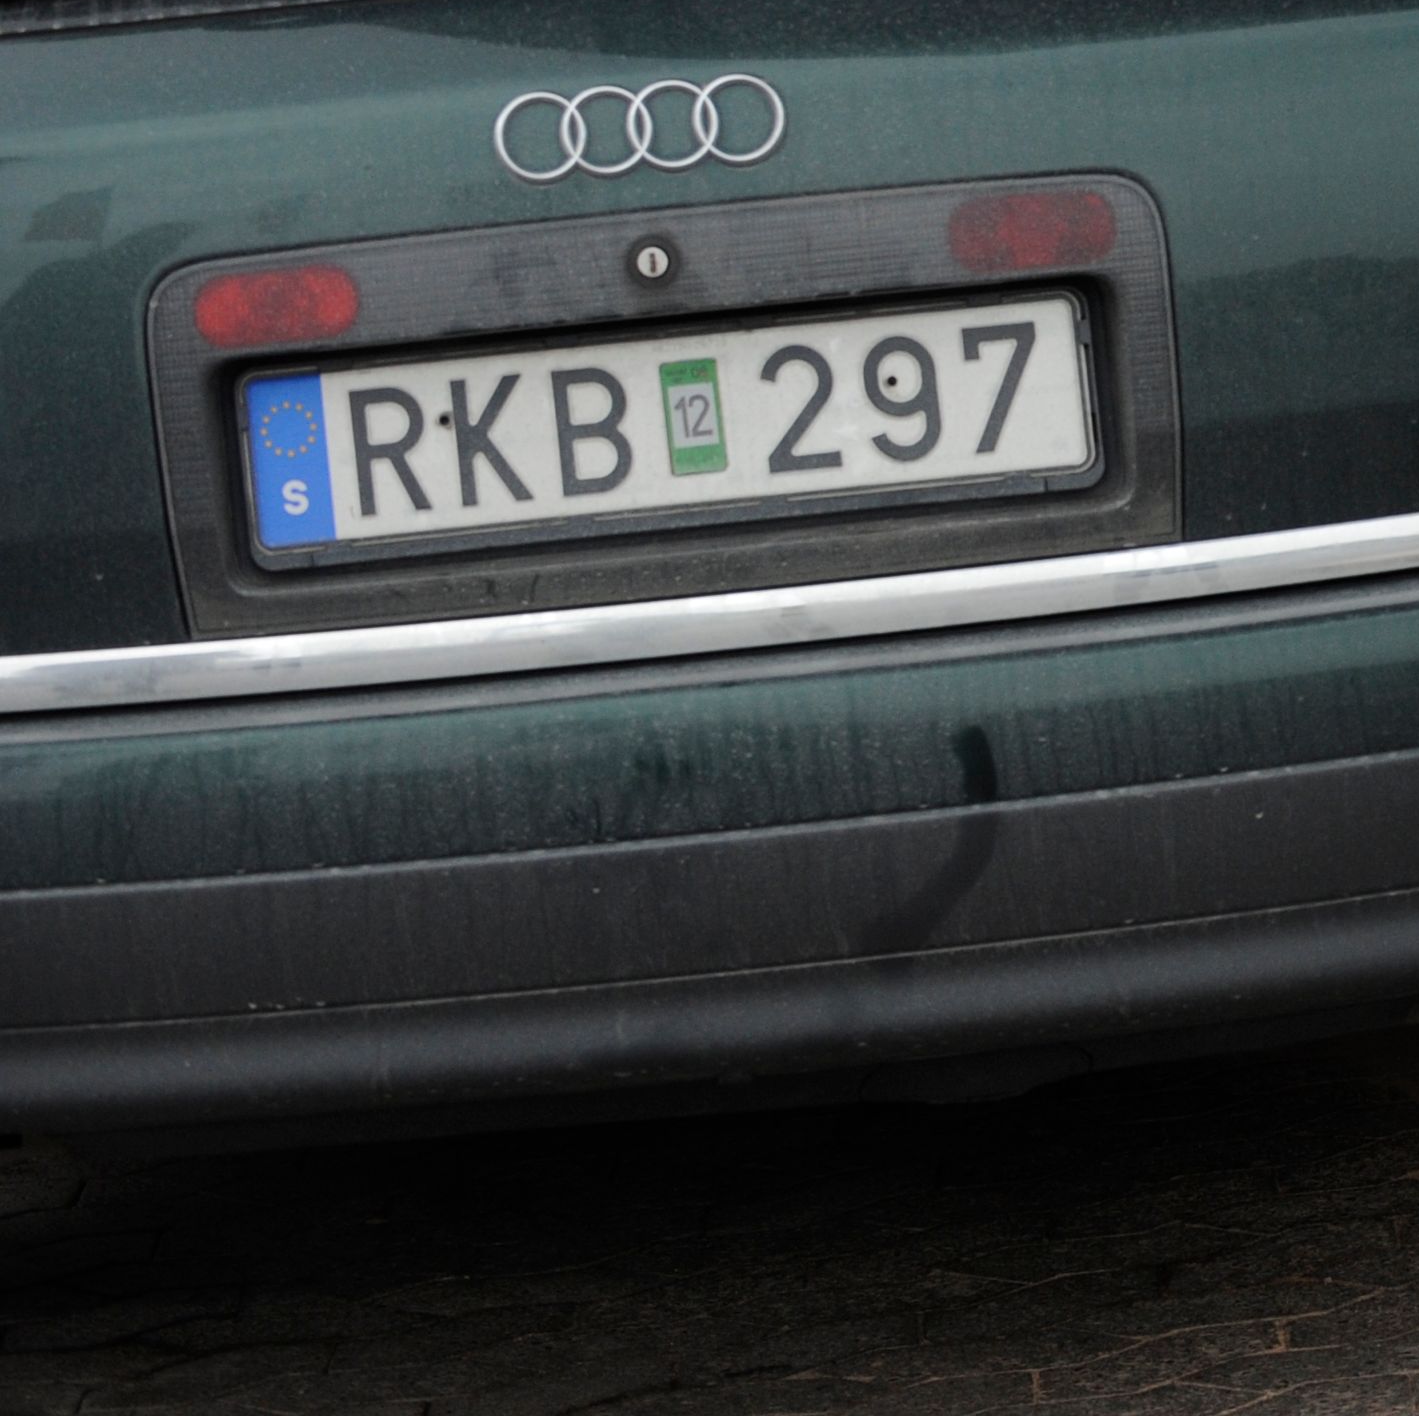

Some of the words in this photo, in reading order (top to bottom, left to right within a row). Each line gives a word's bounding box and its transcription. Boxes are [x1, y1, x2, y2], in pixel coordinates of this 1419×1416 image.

[348, 364, 634, 519] RKB
[760, 321, 1037, 473] 297
[673, 392, 714, 439] 12
[282, 477, 310, 516] S
